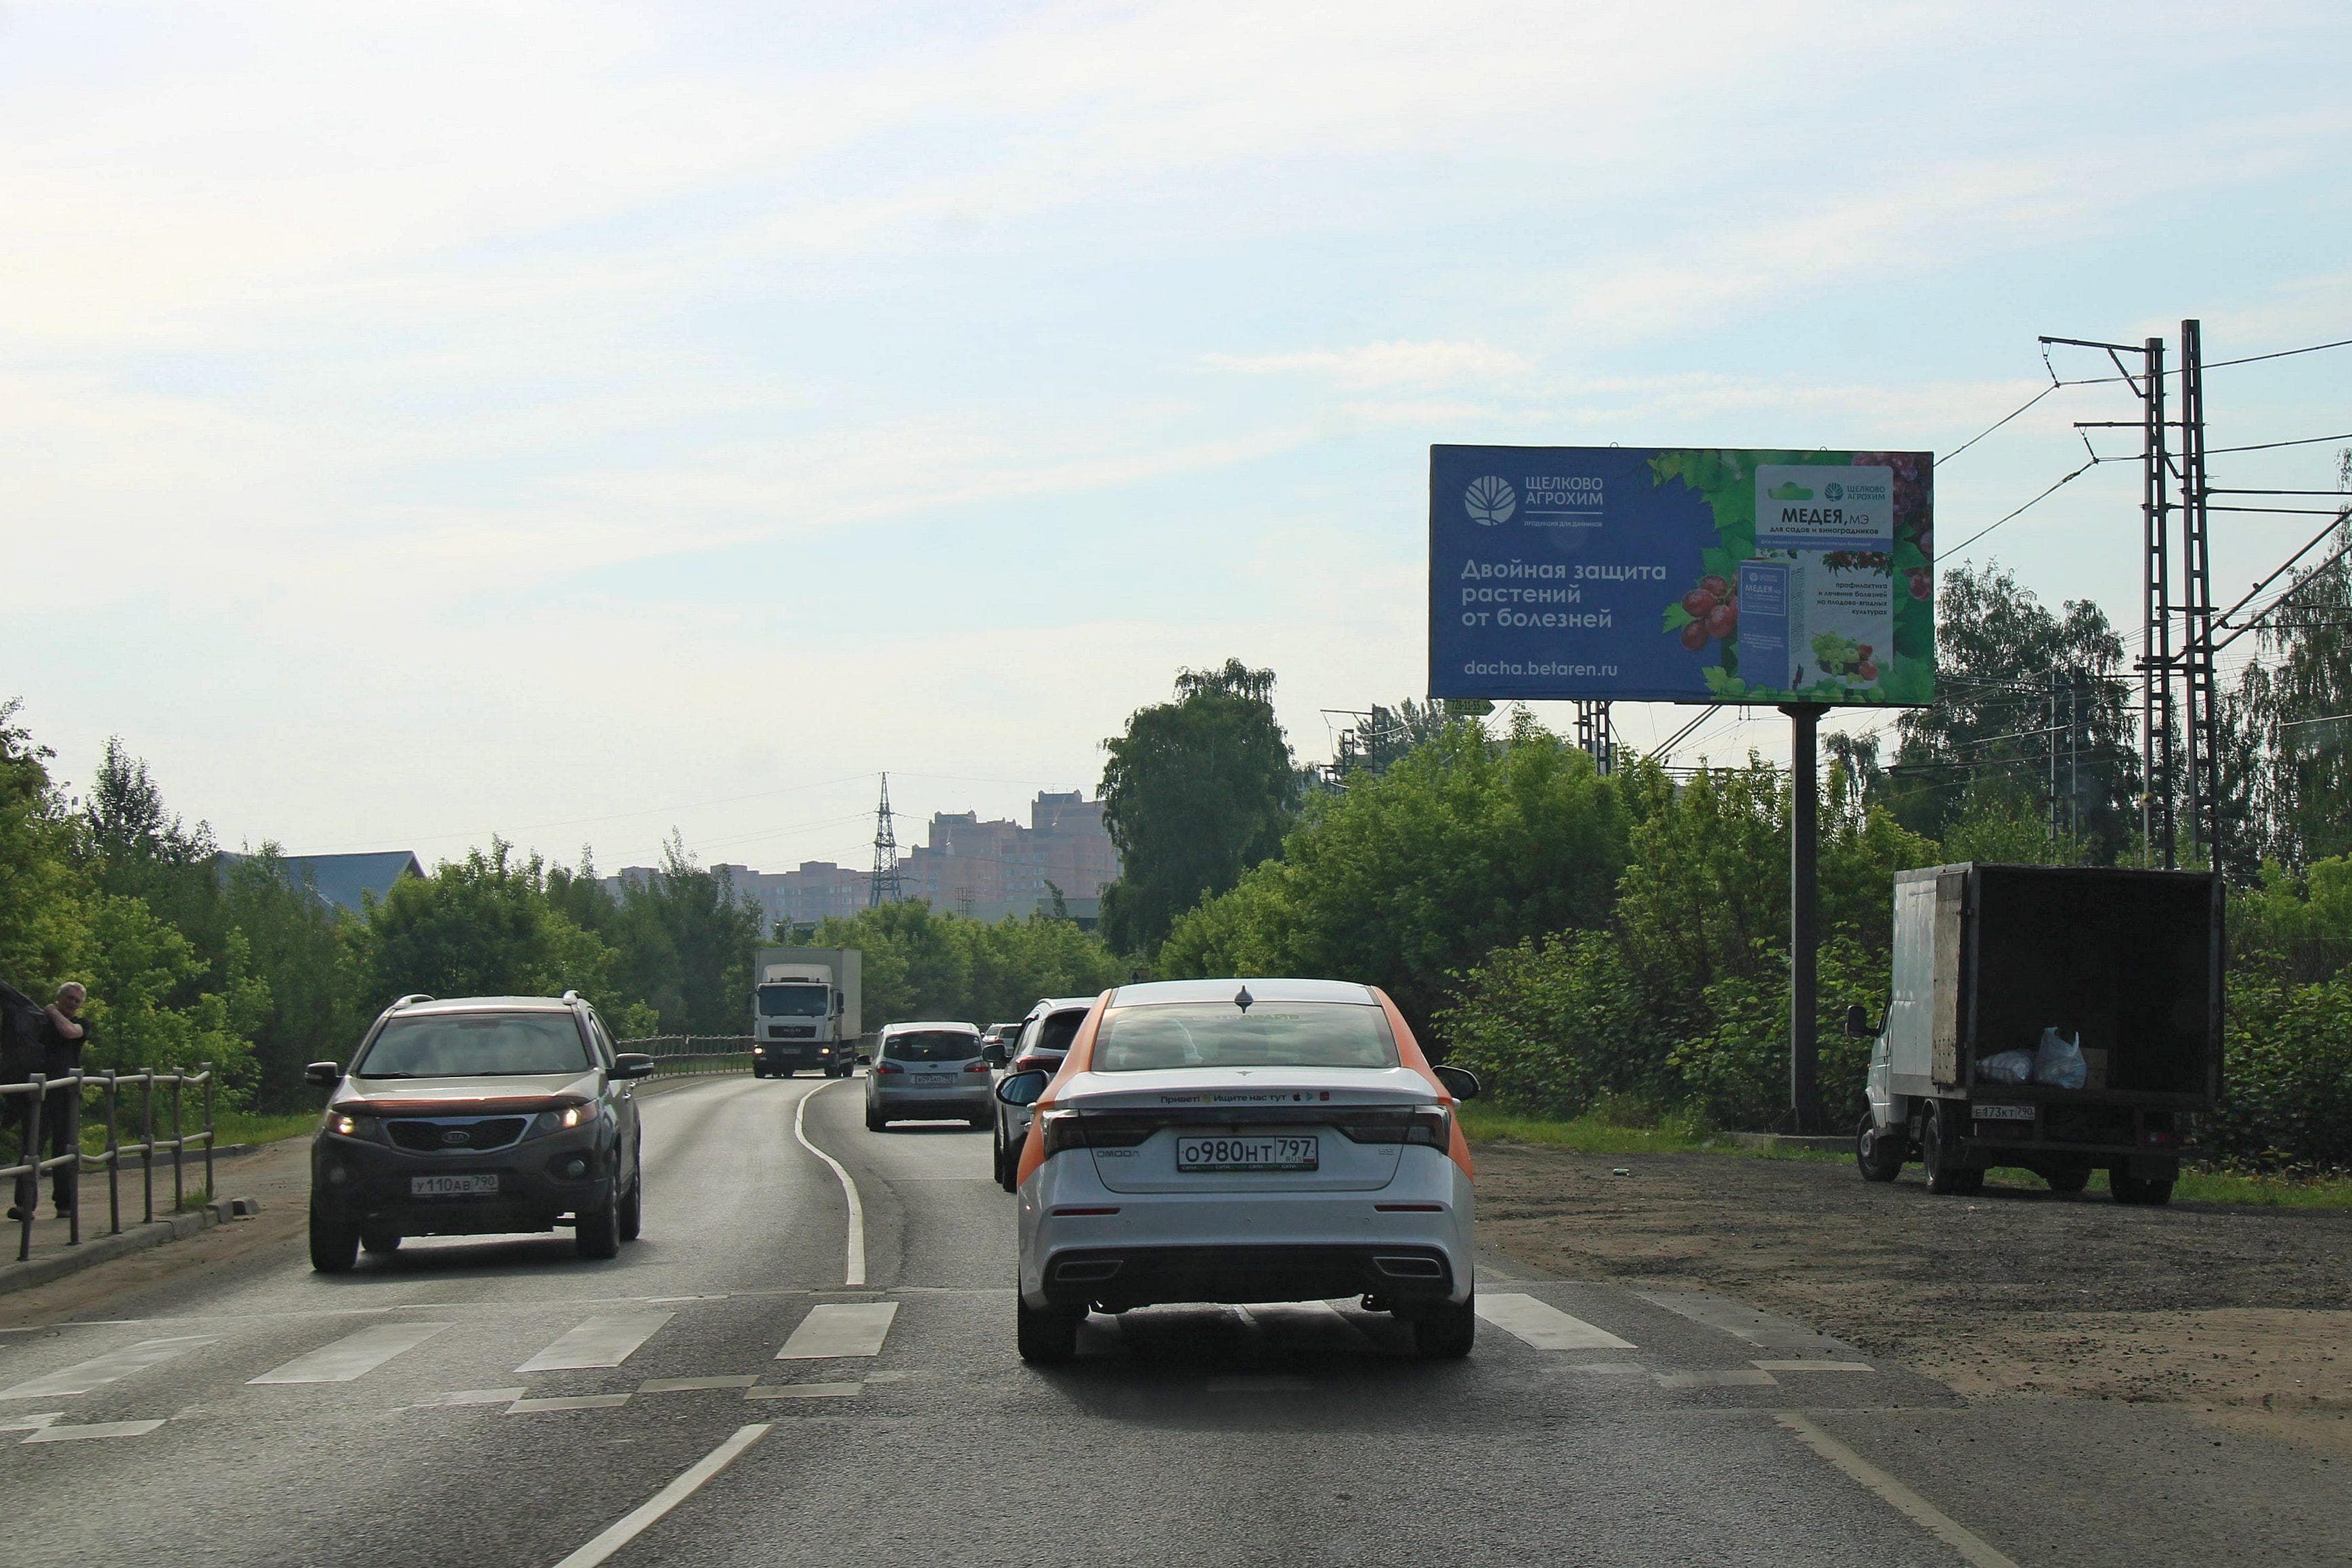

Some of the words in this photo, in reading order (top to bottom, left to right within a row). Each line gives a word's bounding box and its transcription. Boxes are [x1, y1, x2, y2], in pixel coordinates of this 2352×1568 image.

[1525, 477, 1603, 490] ЩЕЛКОВО
[1525, 492, 1603, 505] АГРОХИМ
[1461, 559, 1566, 580] Двойная
[1574, 564, 1666, 582] защита
[1462, 584, 1581, 606] растений
[1461, 611, 1489, 627] от
[1497, 608, 1612, 628] болезней
[1464, 660, 1618, 677] dacha.betaren.ru
[1160, 1094, 1200, 1105] Привет!
[1213, 1093, 1249, 1104] Ищите
[1270, 1093, 1287, 1103] тут
[1185, 1140, 1273, 1163] О980НТ
[1277, 1139, 1312, 1158] 797
[1286, 1155, 1303, 1163] RUS
[473, 1175, 494, 1187] 790
